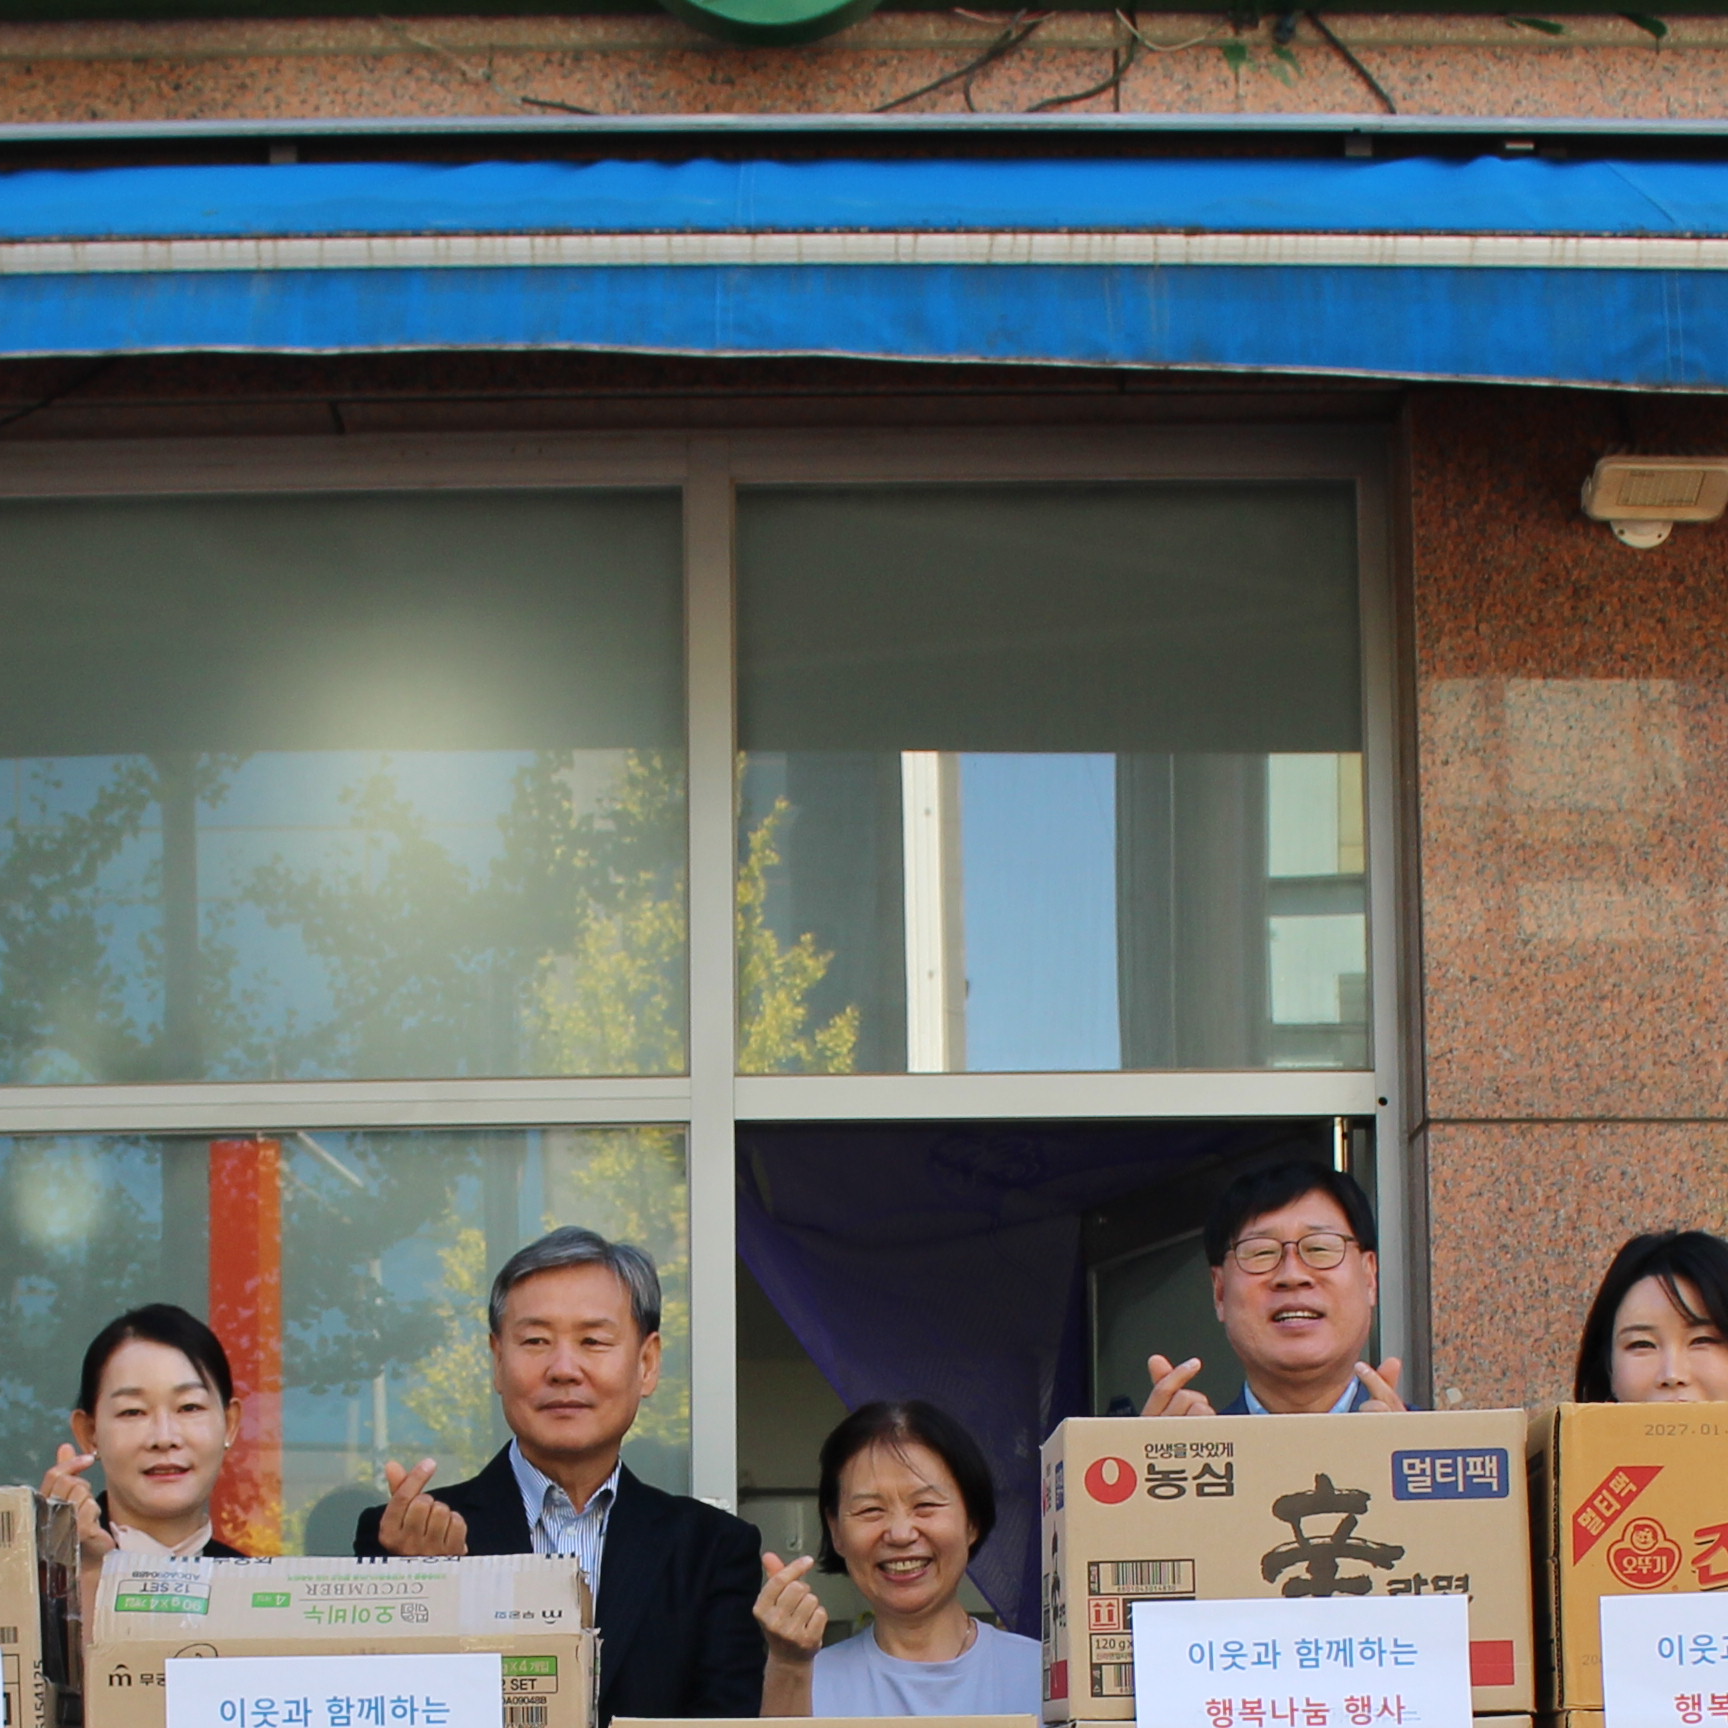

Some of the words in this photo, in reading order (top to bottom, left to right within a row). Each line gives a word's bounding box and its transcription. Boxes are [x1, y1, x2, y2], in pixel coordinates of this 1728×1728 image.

[1143, 1442, 1188, 1459] 인생을
[1189, 1441, 1234, 1458] 맛있게
[1143, 1462, 1235, 1500] 농심
[1401, 1455, 1500, 1493] 멀티팩
[1576, 1470, 1639, 1536] 멀티팩
[1622, 1555, 1668, 1575] 오뚜기
[139, 1582, 169, 1593] SET
[305, 1582, 424, 1596] CUCUMBER
[303, 1604, 395, 1625] 오이비누
[1094, 1638, 1117, 1649] 120
[1187, 1638, 1281, 1672] 이웃과
[1294, 1636, 1419, 1669] 함께하는
[510, 1679, 538, 1691] SET
[219, 1696, 313, 1728] 이웃과
[325, 1694, 451, 1727] 함께하는
[1205, 1696, 1330, 1728] 행복나눔
[1344, 1694, 1406, 1726] 행사
